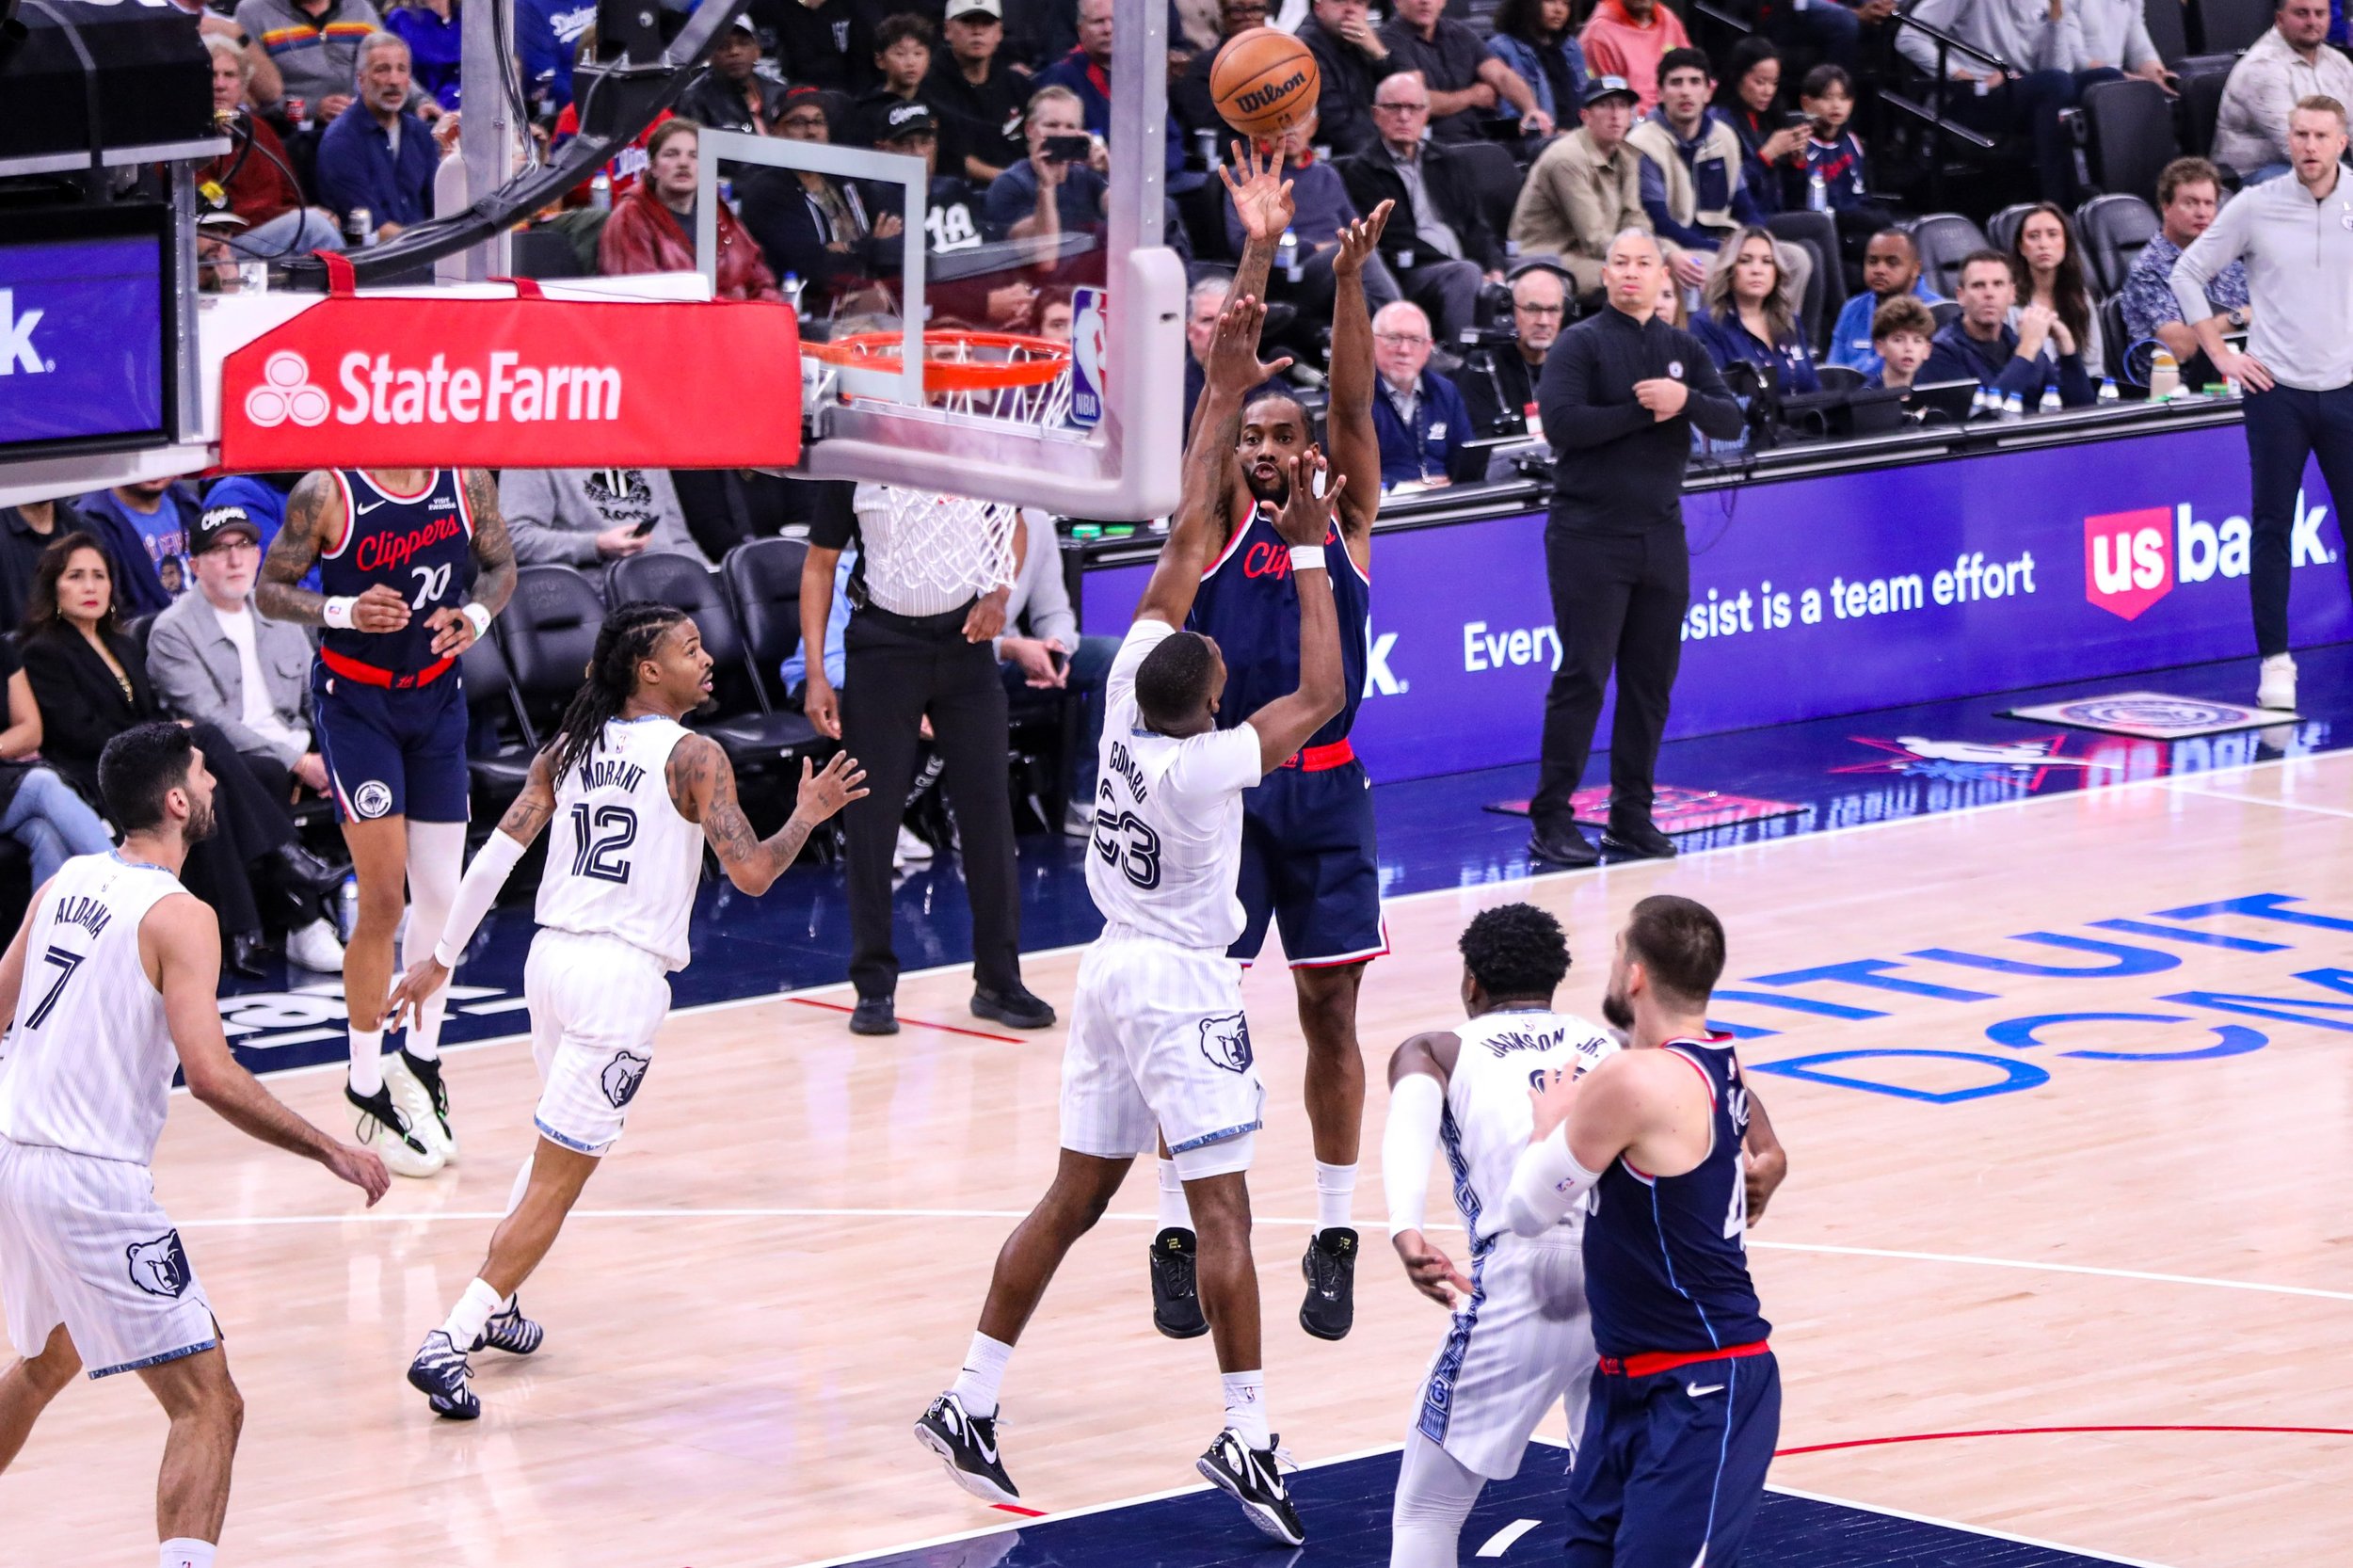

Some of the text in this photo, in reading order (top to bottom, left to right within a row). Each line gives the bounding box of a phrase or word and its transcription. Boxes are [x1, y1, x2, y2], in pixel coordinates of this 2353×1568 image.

[1235, 72, 1306, 113] Wilson
[1075, 392, 1096, 416] NBA
[357, 513, 460, 571] Clippers
[2093, 487, 2329, 595] us bak
[1680, 587, 1753, 642] sist
[1761, 580, 1792, 629] is
[1801, 587, 1822, 624] a
[1830, 576, 1924, 619] team
[1931, 551, 2036, 605] effort
[579, 760, 647, 793] MORANT
[570, 803, 638, 885] 12
[1094, 777, 1160, 890] 23
[24, 945, 87, 1031] 7
